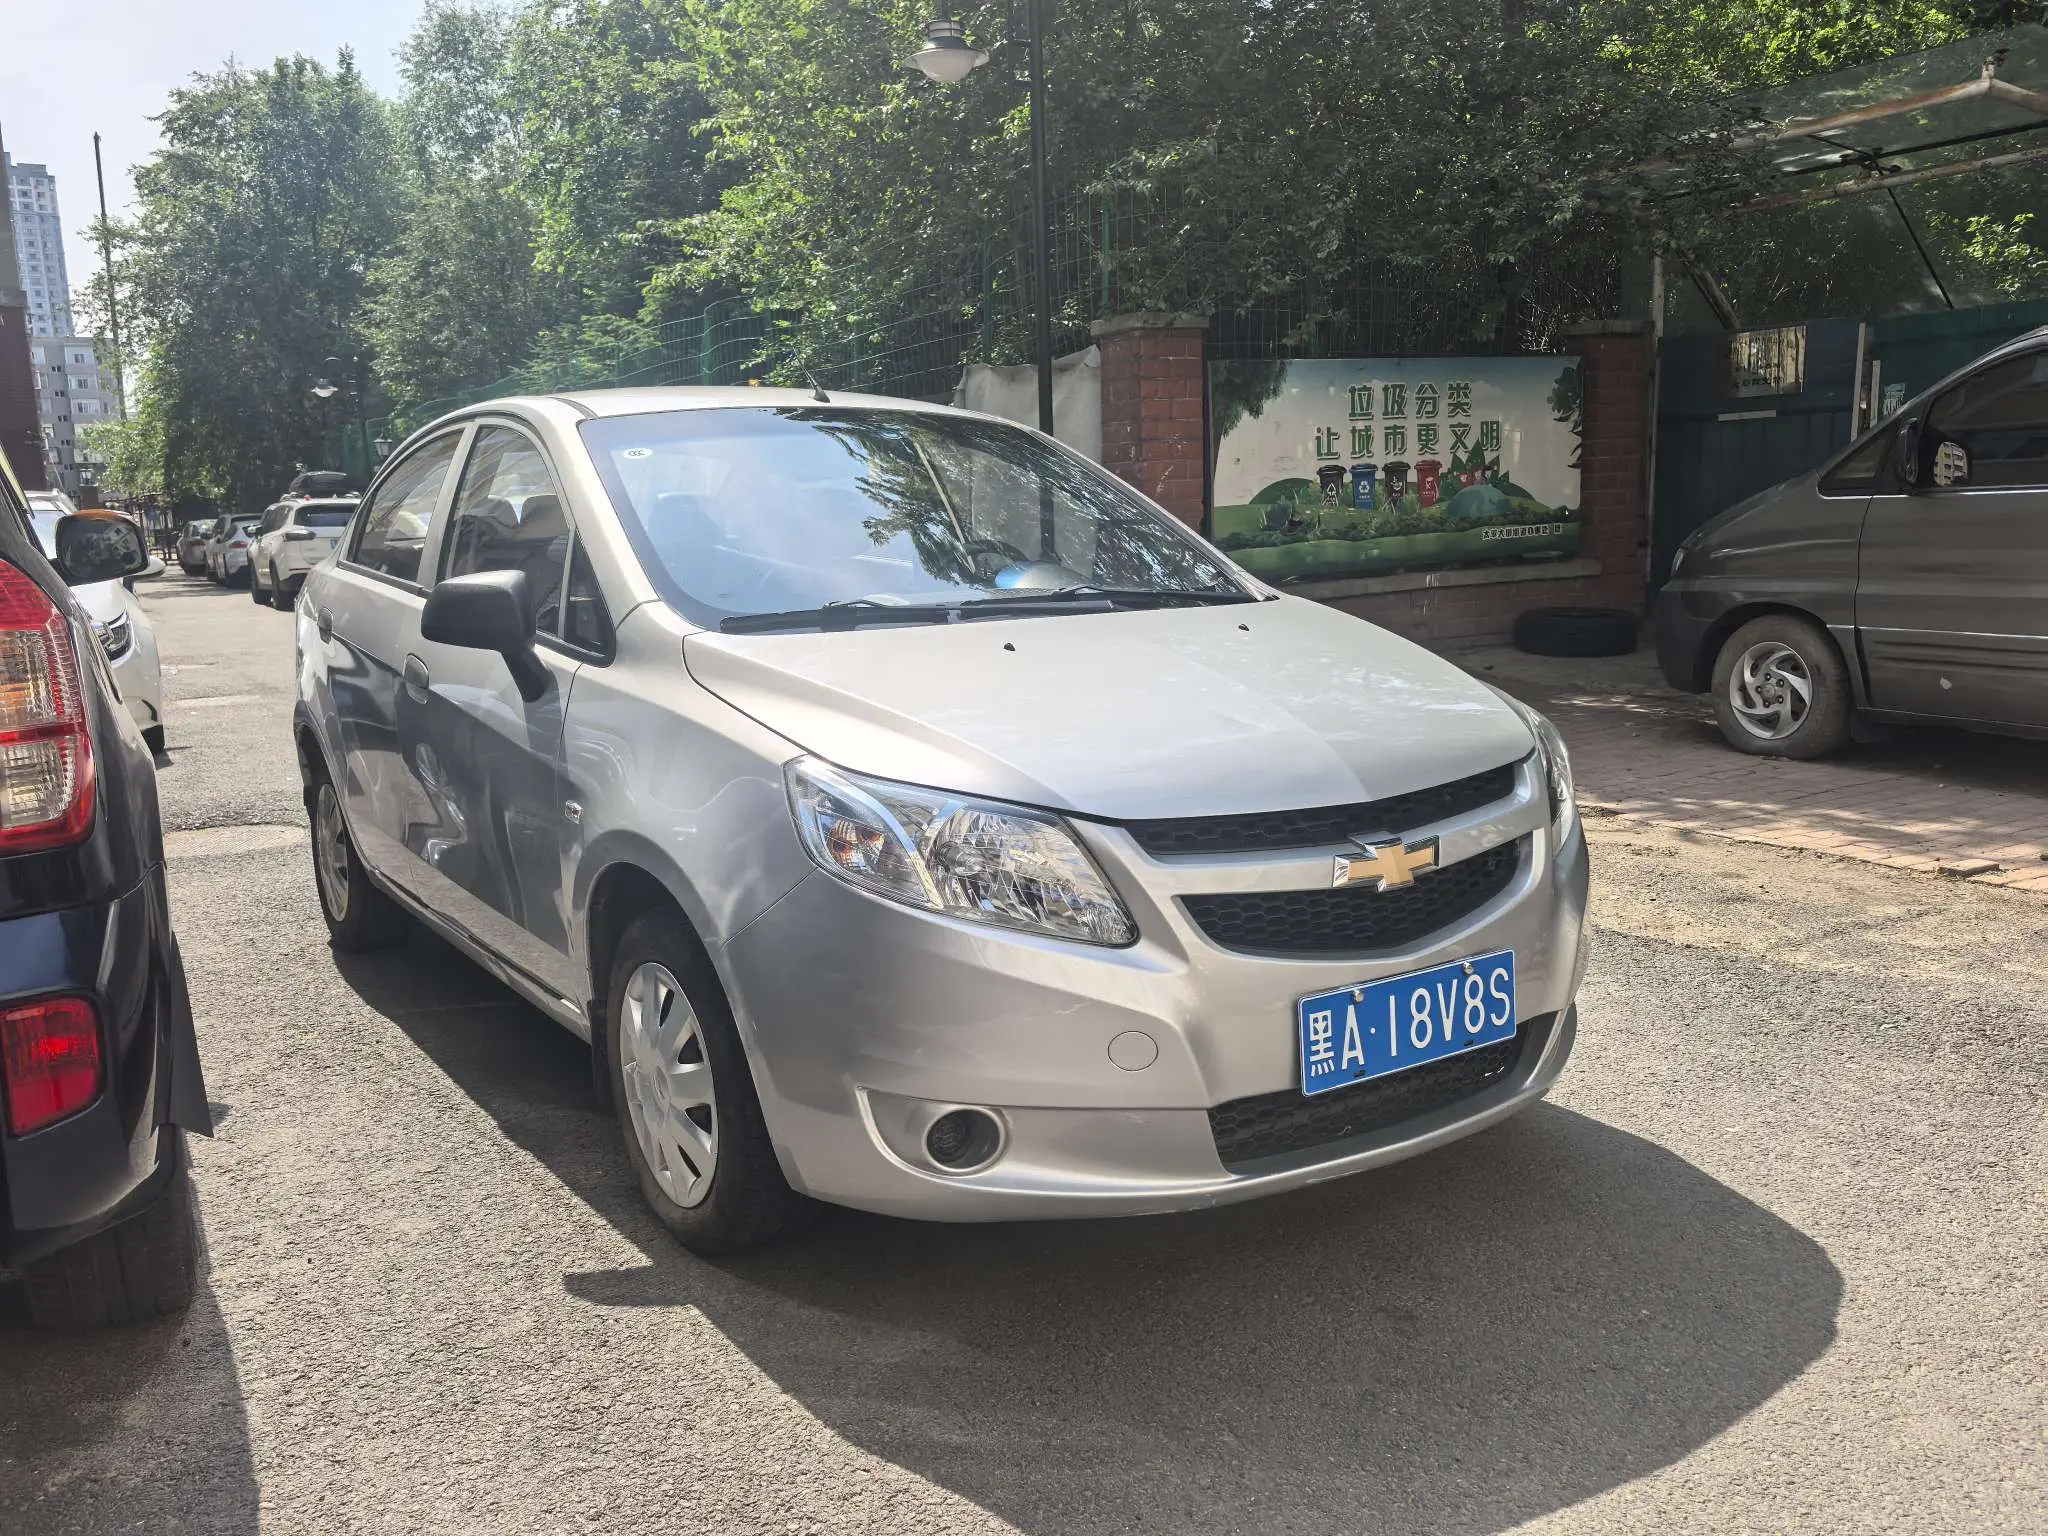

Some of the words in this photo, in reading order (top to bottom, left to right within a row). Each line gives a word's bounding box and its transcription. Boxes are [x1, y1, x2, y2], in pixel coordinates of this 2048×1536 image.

[1348, 382, 1473, 420] 垃圾分类
[1315, 420, 1502, 460] 让城市更文明
